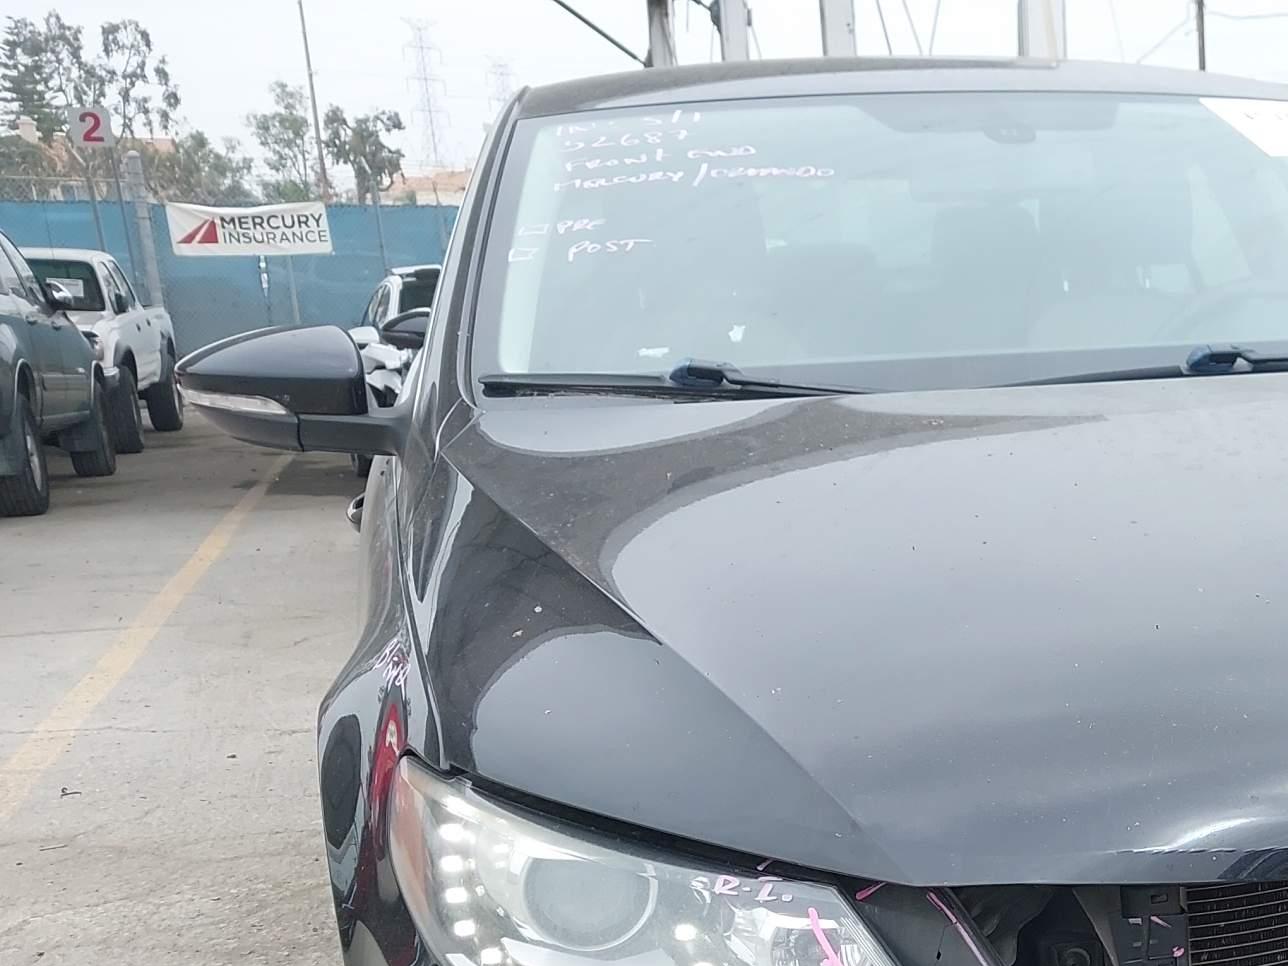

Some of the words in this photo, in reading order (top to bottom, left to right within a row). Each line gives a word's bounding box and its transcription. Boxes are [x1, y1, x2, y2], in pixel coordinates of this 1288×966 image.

[79, 112, 105, 142] 2
[219, 213, 323, 231] MERCURY
[222, 230, 329, 244] INSURANCE
